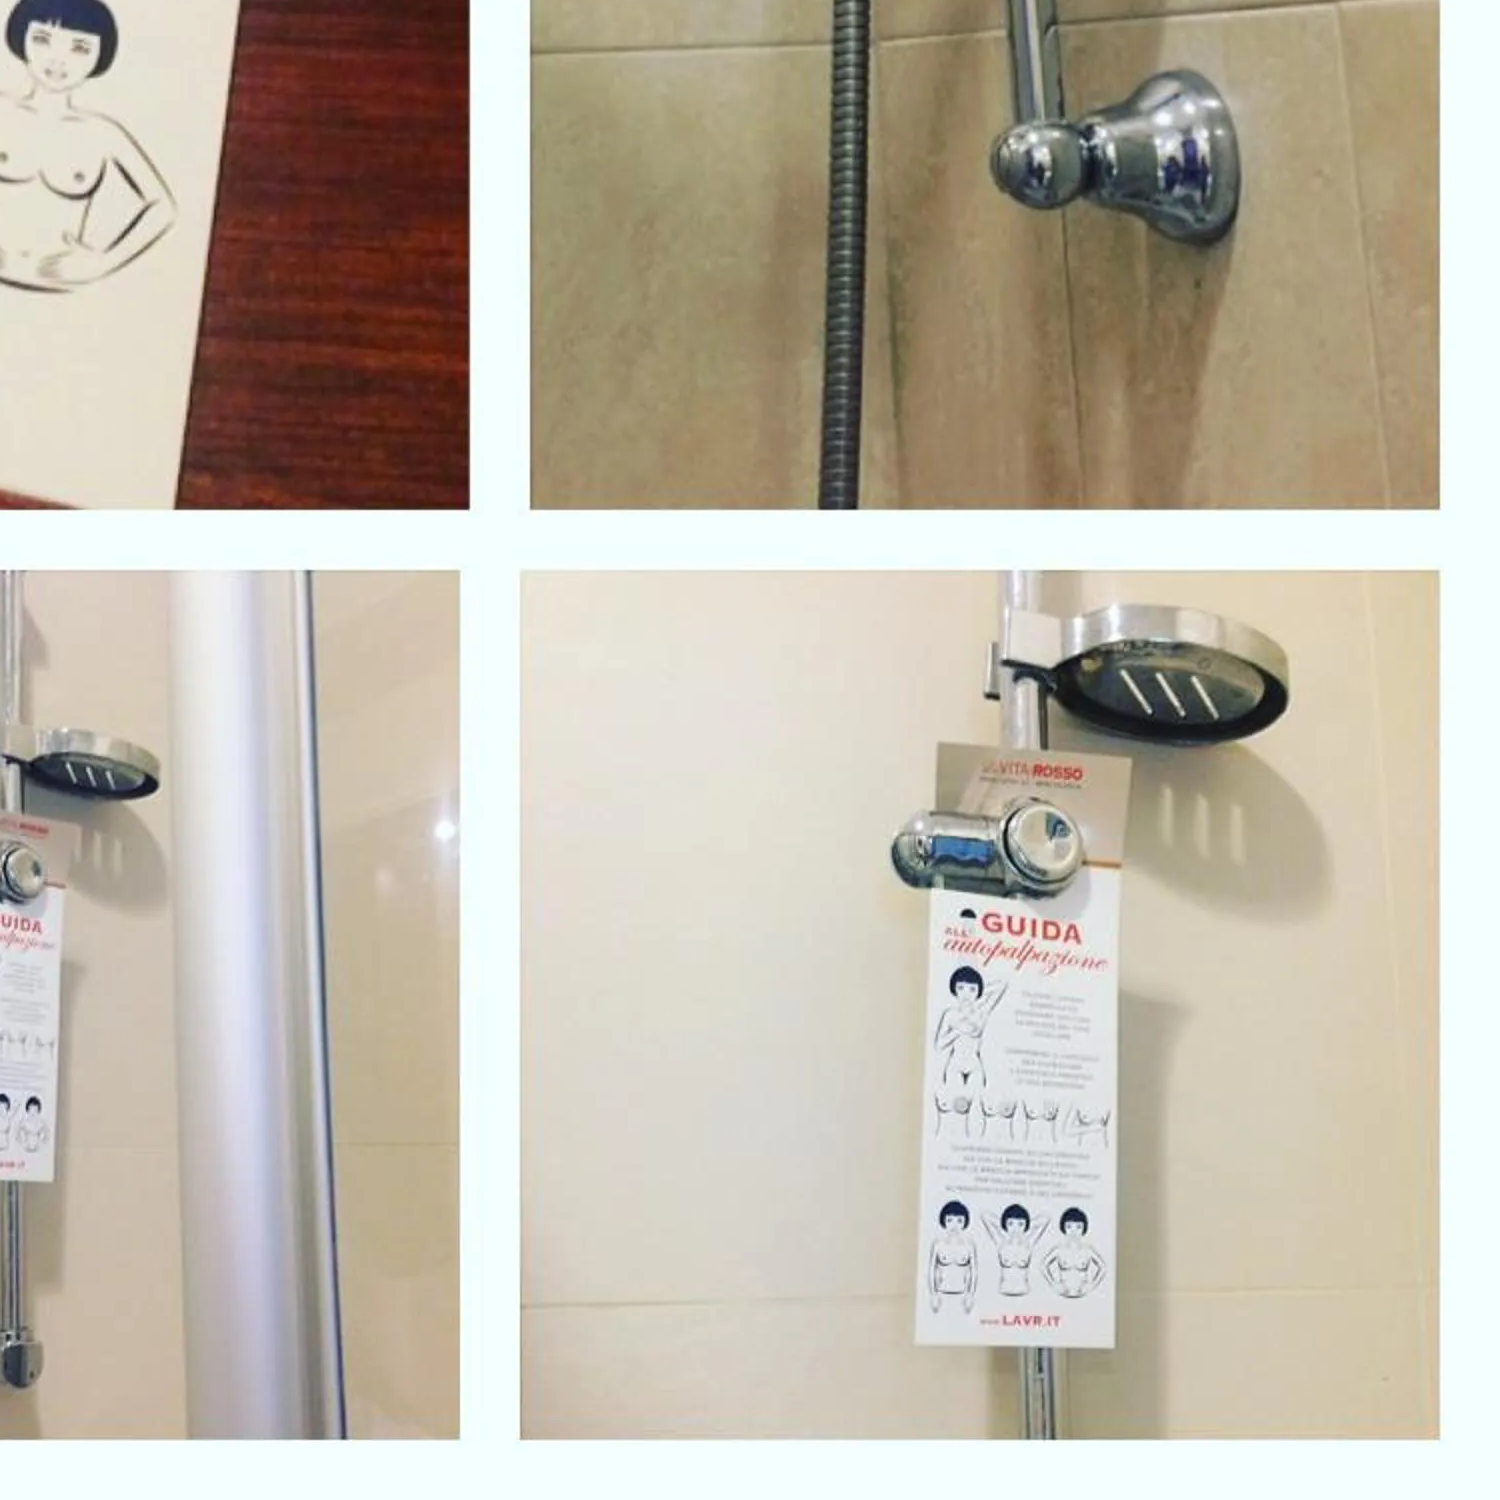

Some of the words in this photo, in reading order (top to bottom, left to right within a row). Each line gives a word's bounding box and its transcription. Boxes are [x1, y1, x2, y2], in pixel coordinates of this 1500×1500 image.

[1032, 763, 1084, 781] ROSSO
[981, 912, 1081, 945] GUIDA
[943, 936, 1107, 974] autopalpazione
